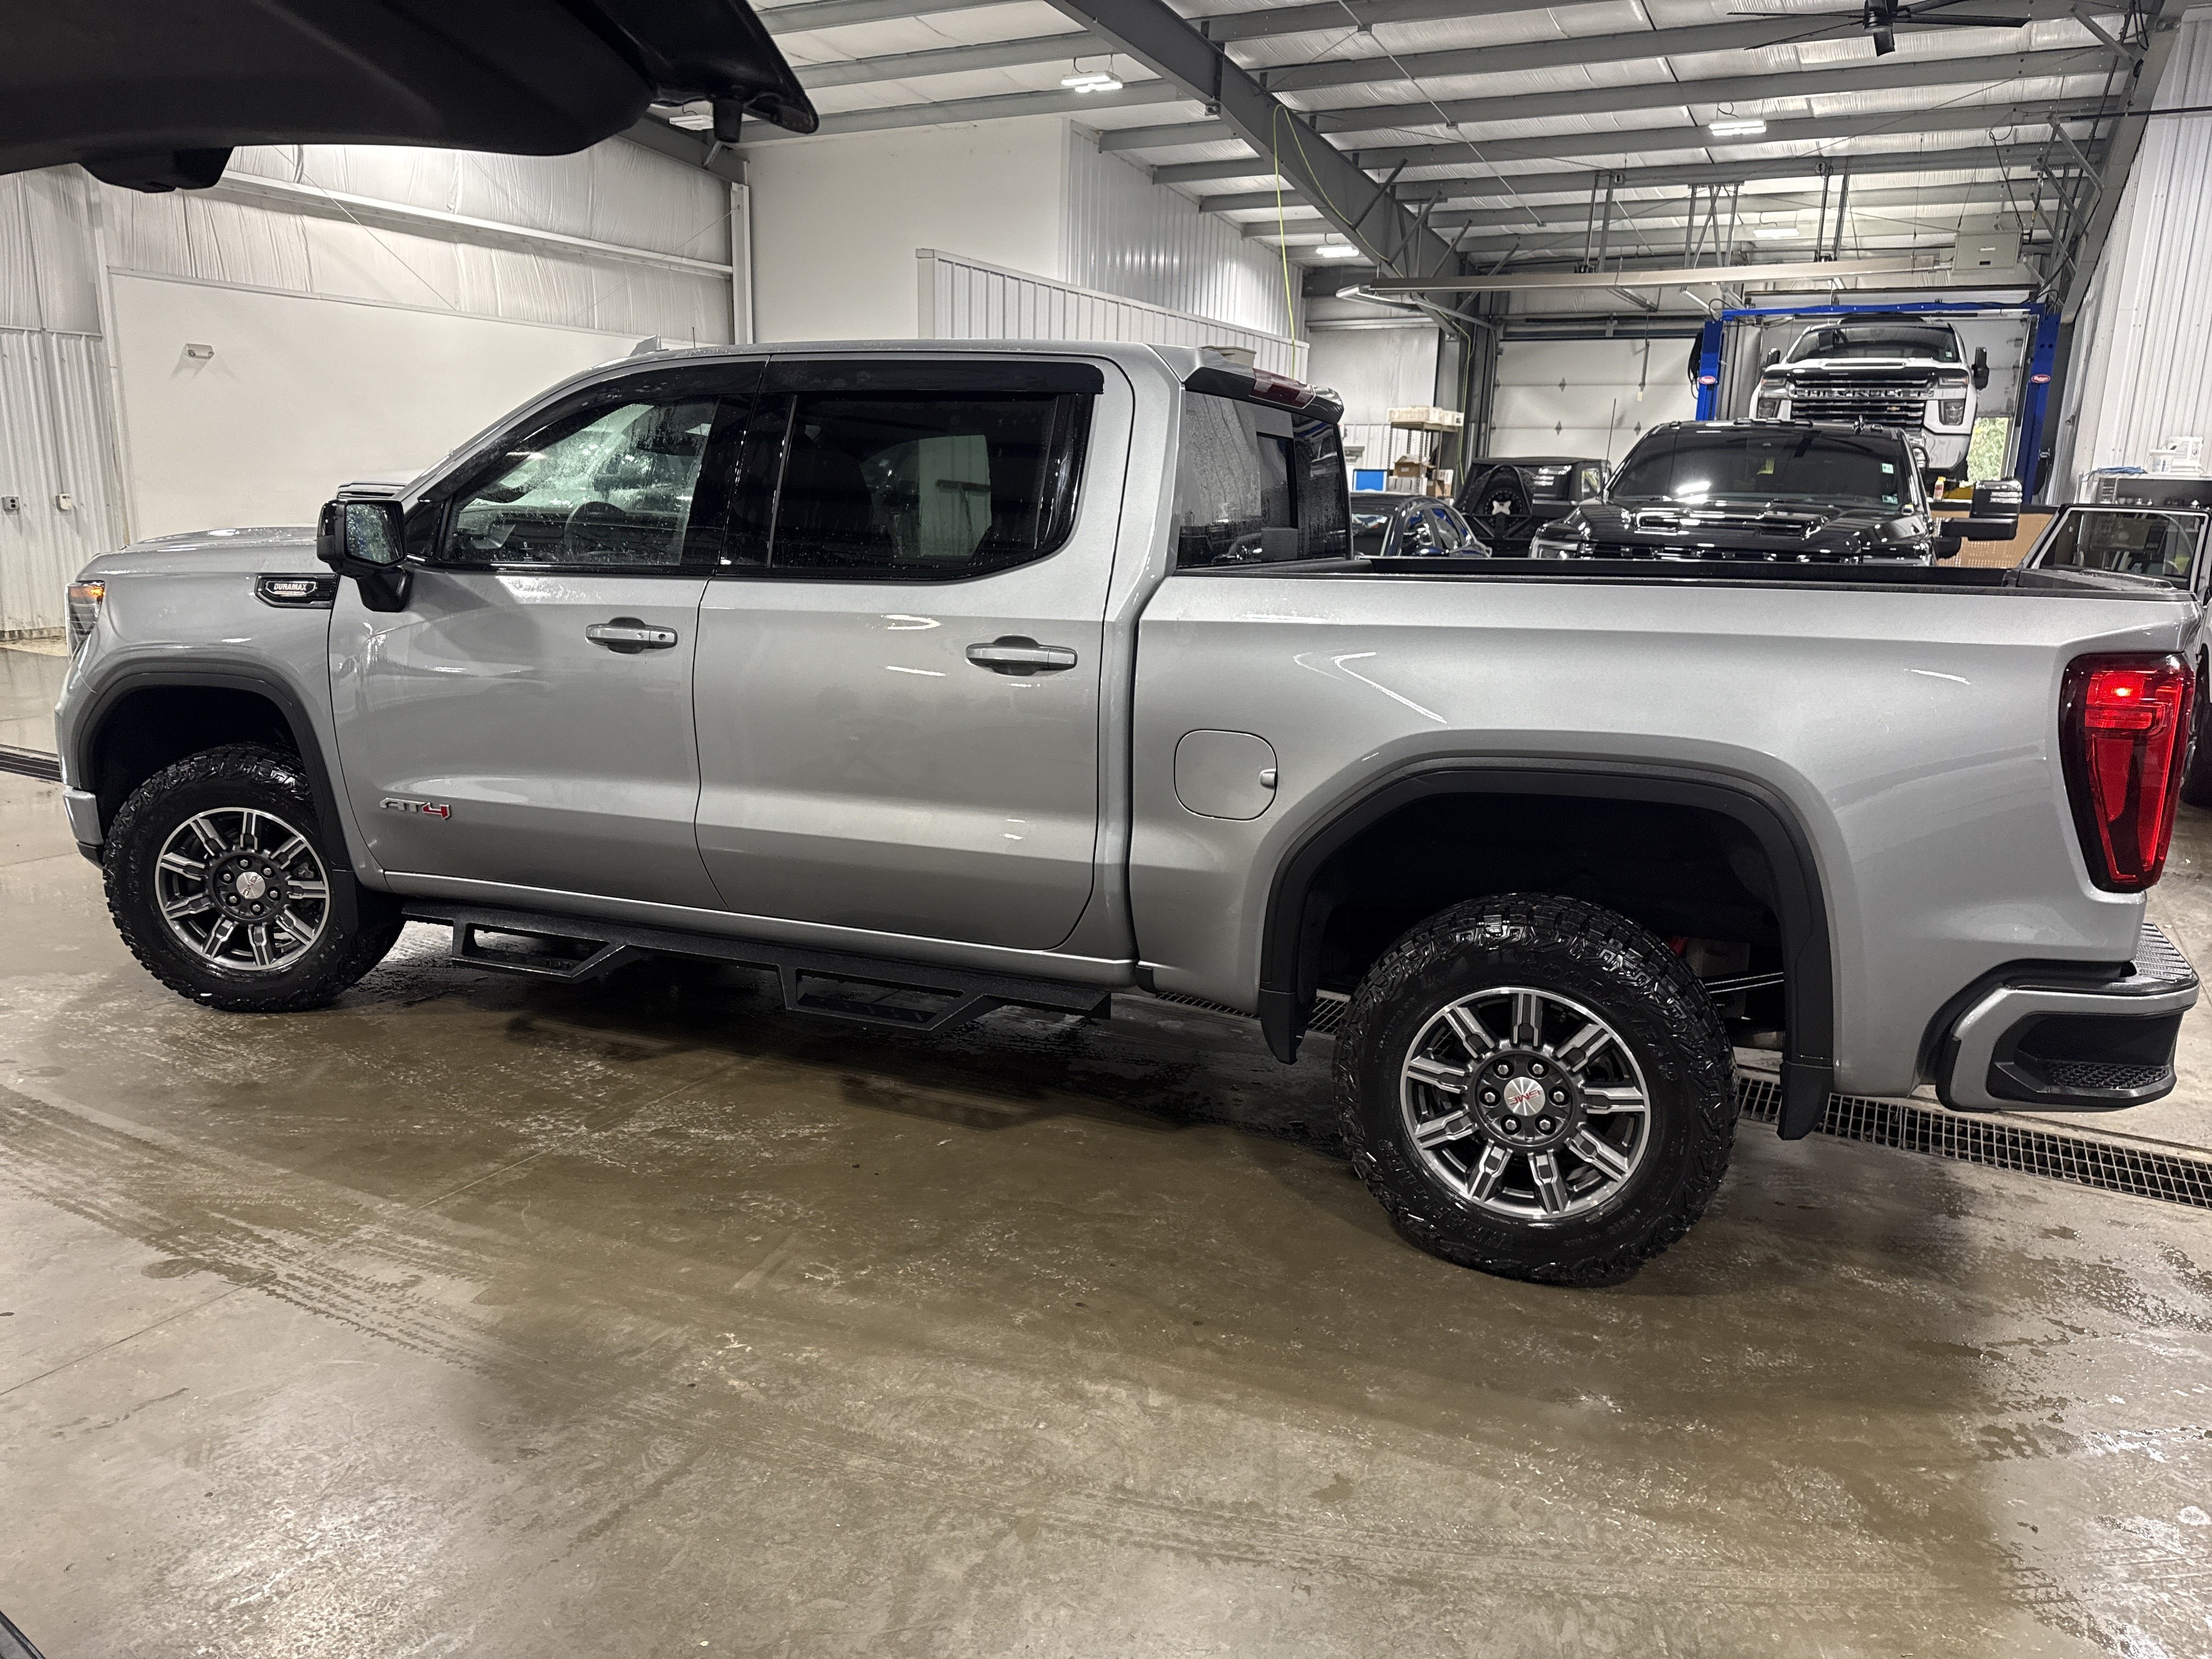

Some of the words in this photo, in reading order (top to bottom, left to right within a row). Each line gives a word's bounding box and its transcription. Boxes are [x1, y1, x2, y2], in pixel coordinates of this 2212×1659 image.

[274, 583, 307, 591] DURAMAX
[380, 797, 450, 820] AT4
[242, 876, 258, 896] GMC
[1506, 1089, 1541, 1105] GMC
